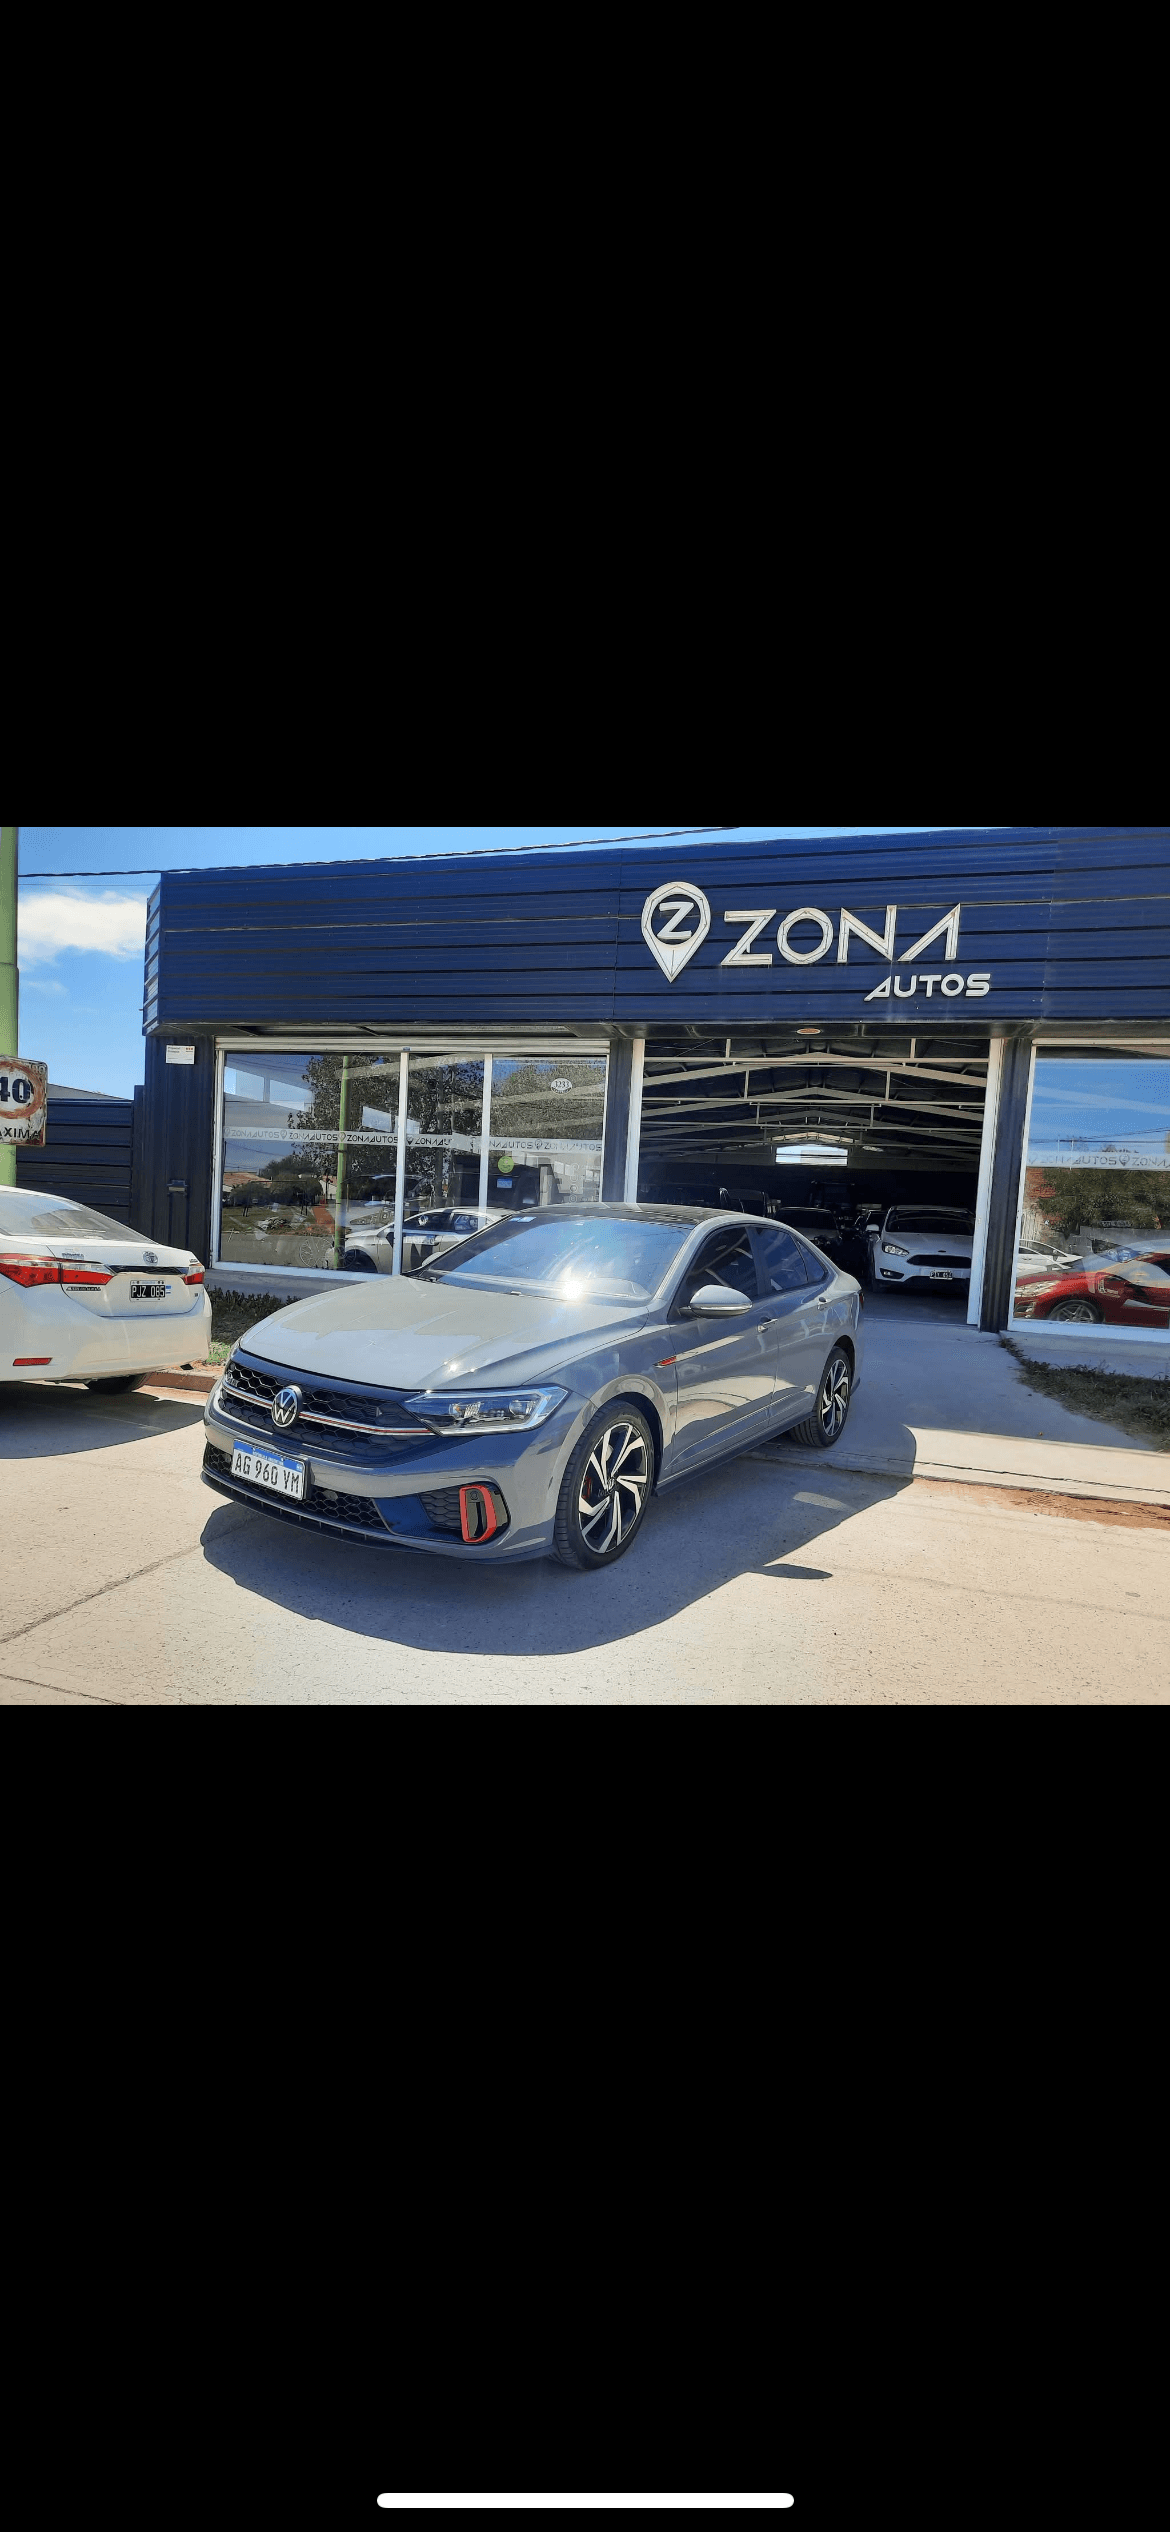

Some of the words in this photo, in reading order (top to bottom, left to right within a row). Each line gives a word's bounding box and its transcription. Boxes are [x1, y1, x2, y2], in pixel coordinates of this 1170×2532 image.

[720, 902, 961, 966] ZONA
[863, 972, 991, 1002] AUTOS
[131, 1285, 147, 1298] PJZ
[234, 1453, 251, 1475] AG
[255, 1459, 278, 1485] 960
[283, 1469, 300, 1494] YM
